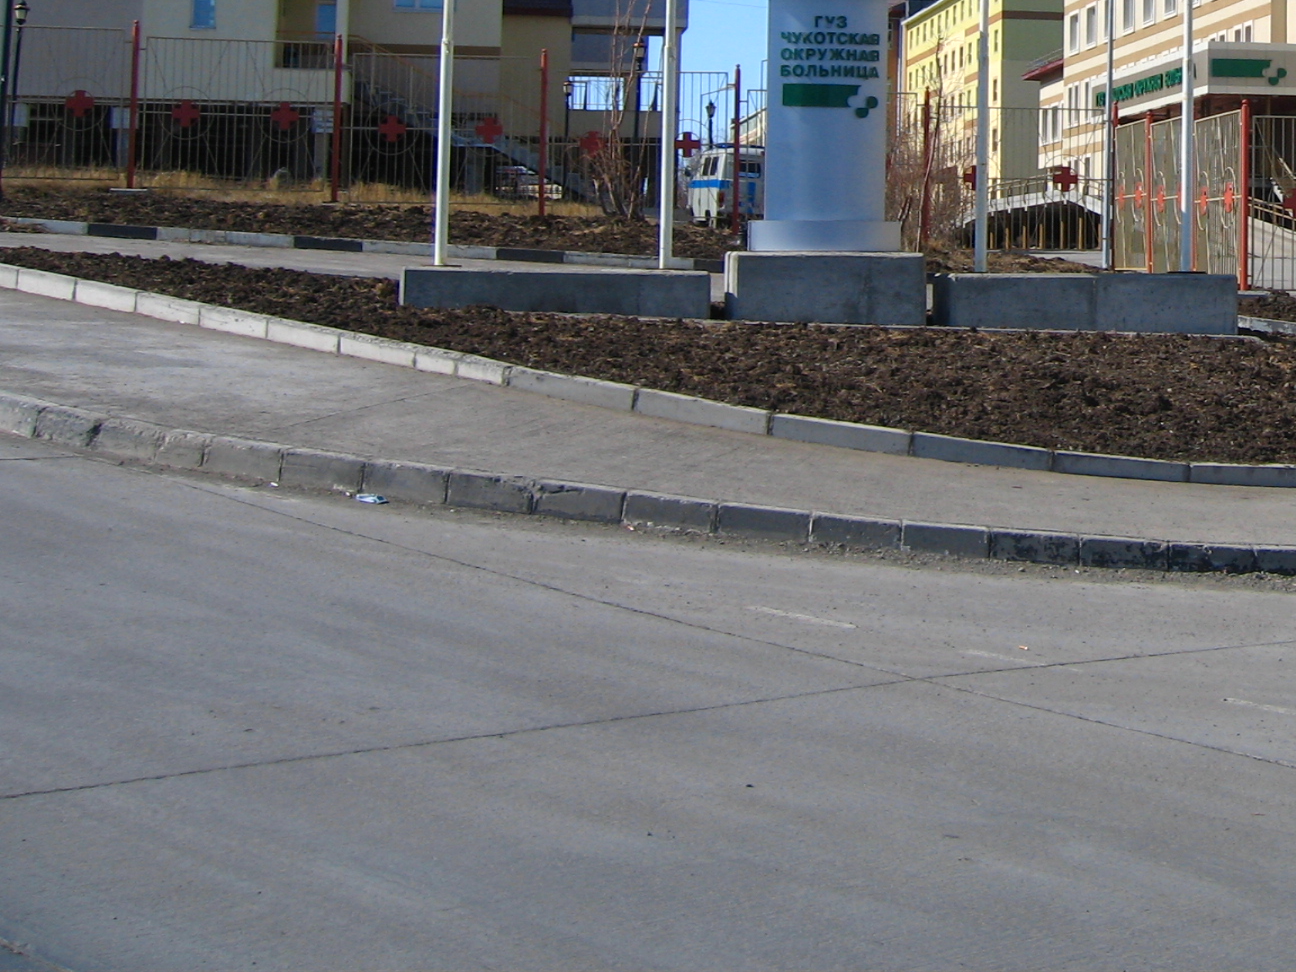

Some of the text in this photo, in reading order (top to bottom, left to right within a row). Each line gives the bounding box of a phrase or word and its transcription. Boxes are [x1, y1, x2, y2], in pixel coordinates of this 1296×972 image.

[814, 15, 848, 29] ГУЗ
[780, 31, 880, 46] ЧУКОТСКАЯ
[780, 48, 880, 62] ОКРУЖНАЯ
[780, 64, 880, 80] БОЛЬНИЦА
